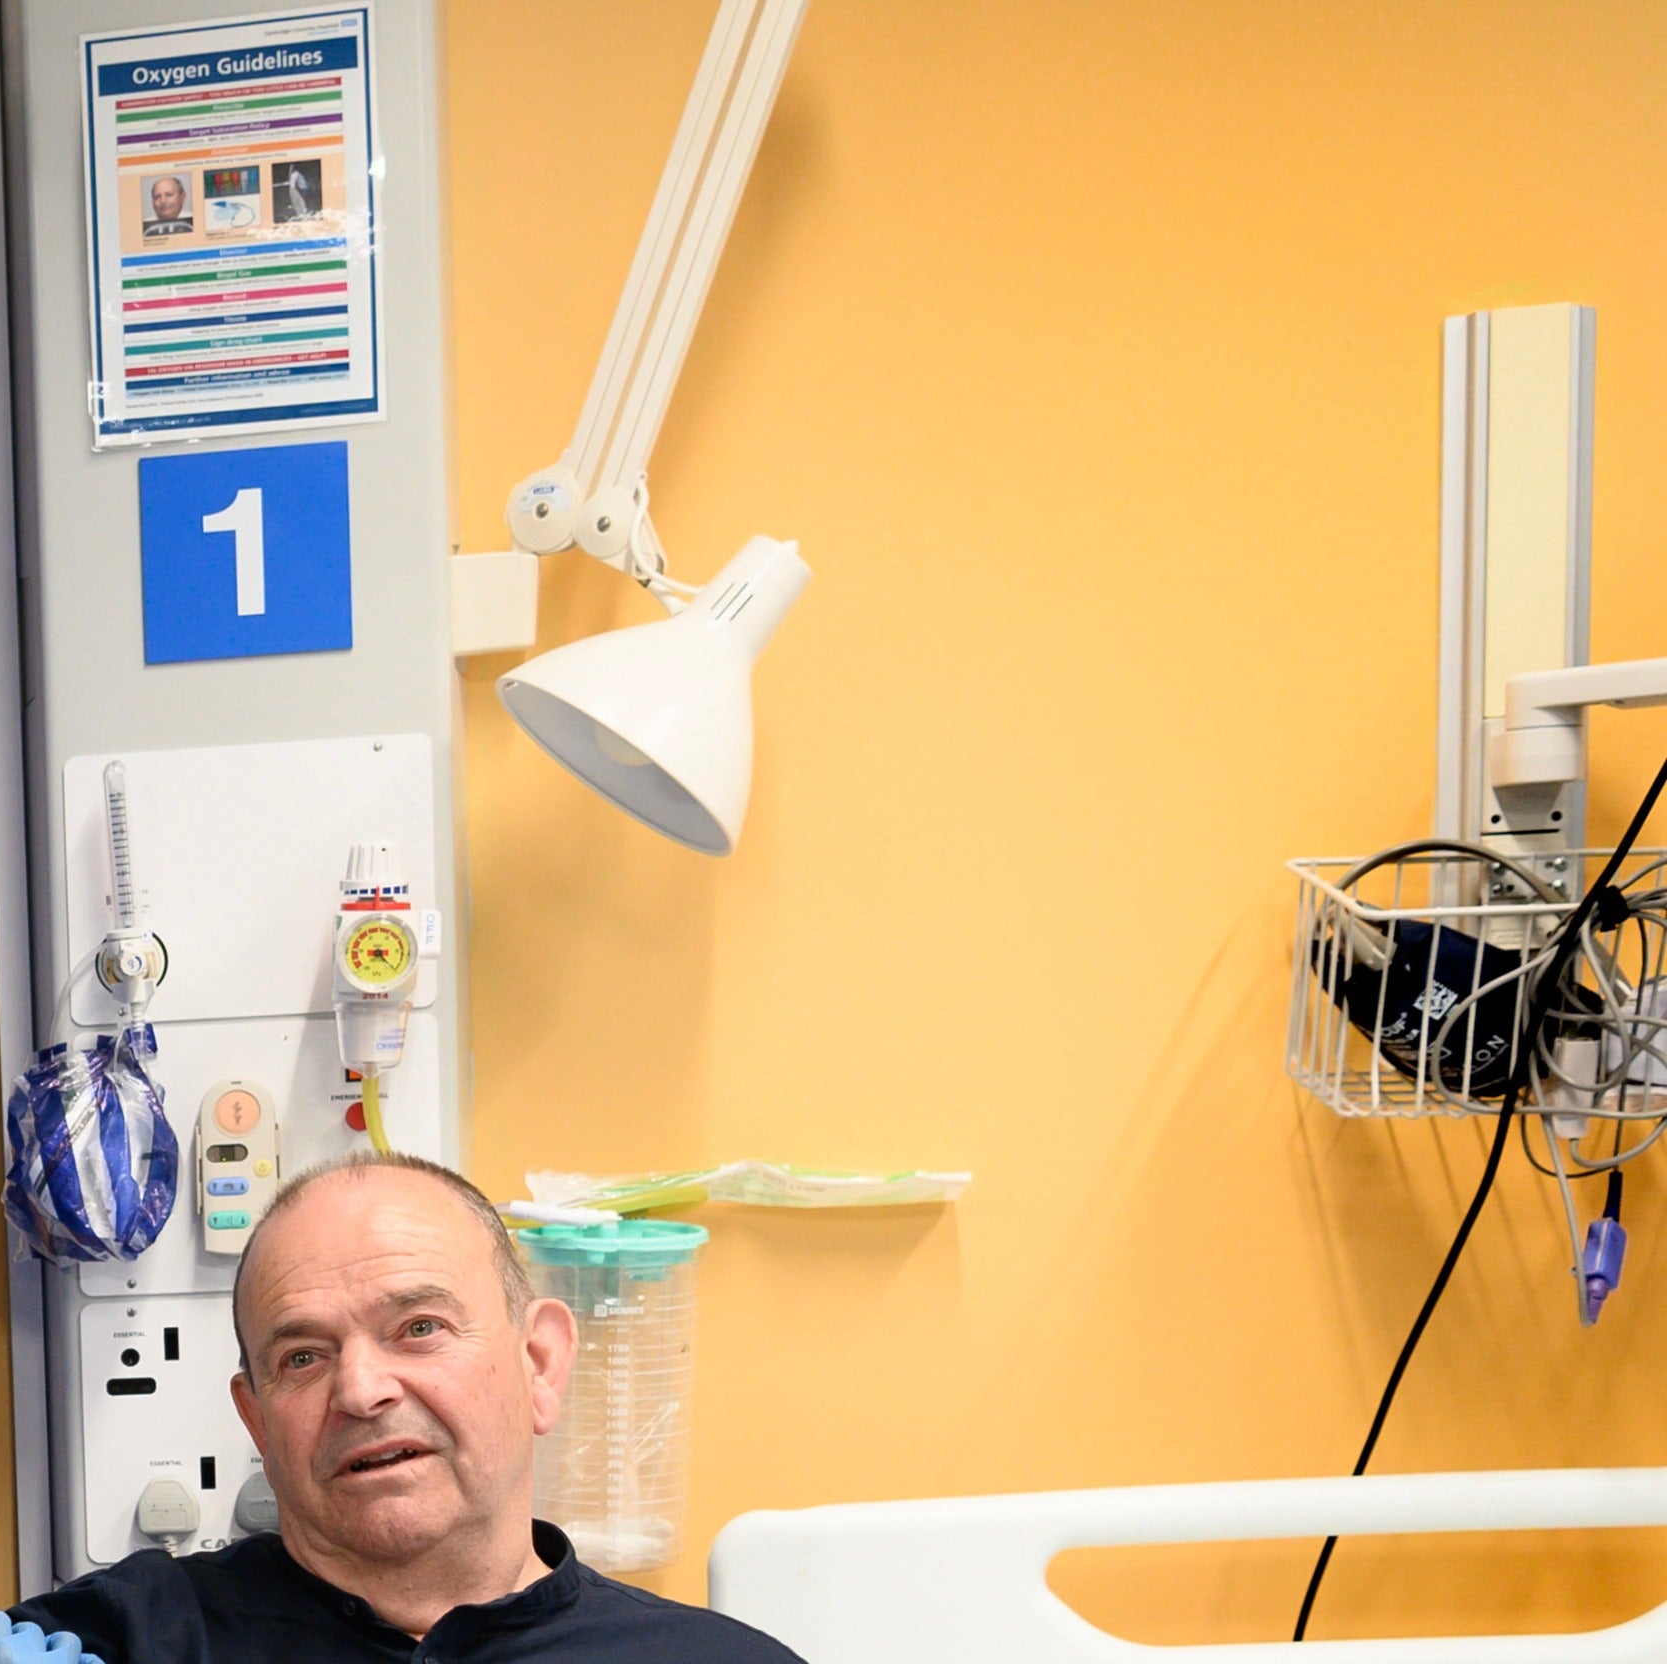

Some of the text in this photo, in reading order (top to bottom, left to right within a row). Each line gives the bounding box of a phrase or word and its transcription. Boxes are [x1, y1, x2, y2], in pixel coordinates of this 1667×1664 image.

[132, 49, 323, 86] Oxygen Guidelines
[202, 487, 266, 617] 1
[362, 992, 389, 1000] 2014
[113, 1331, 147, 1339] ESSENTIAL
